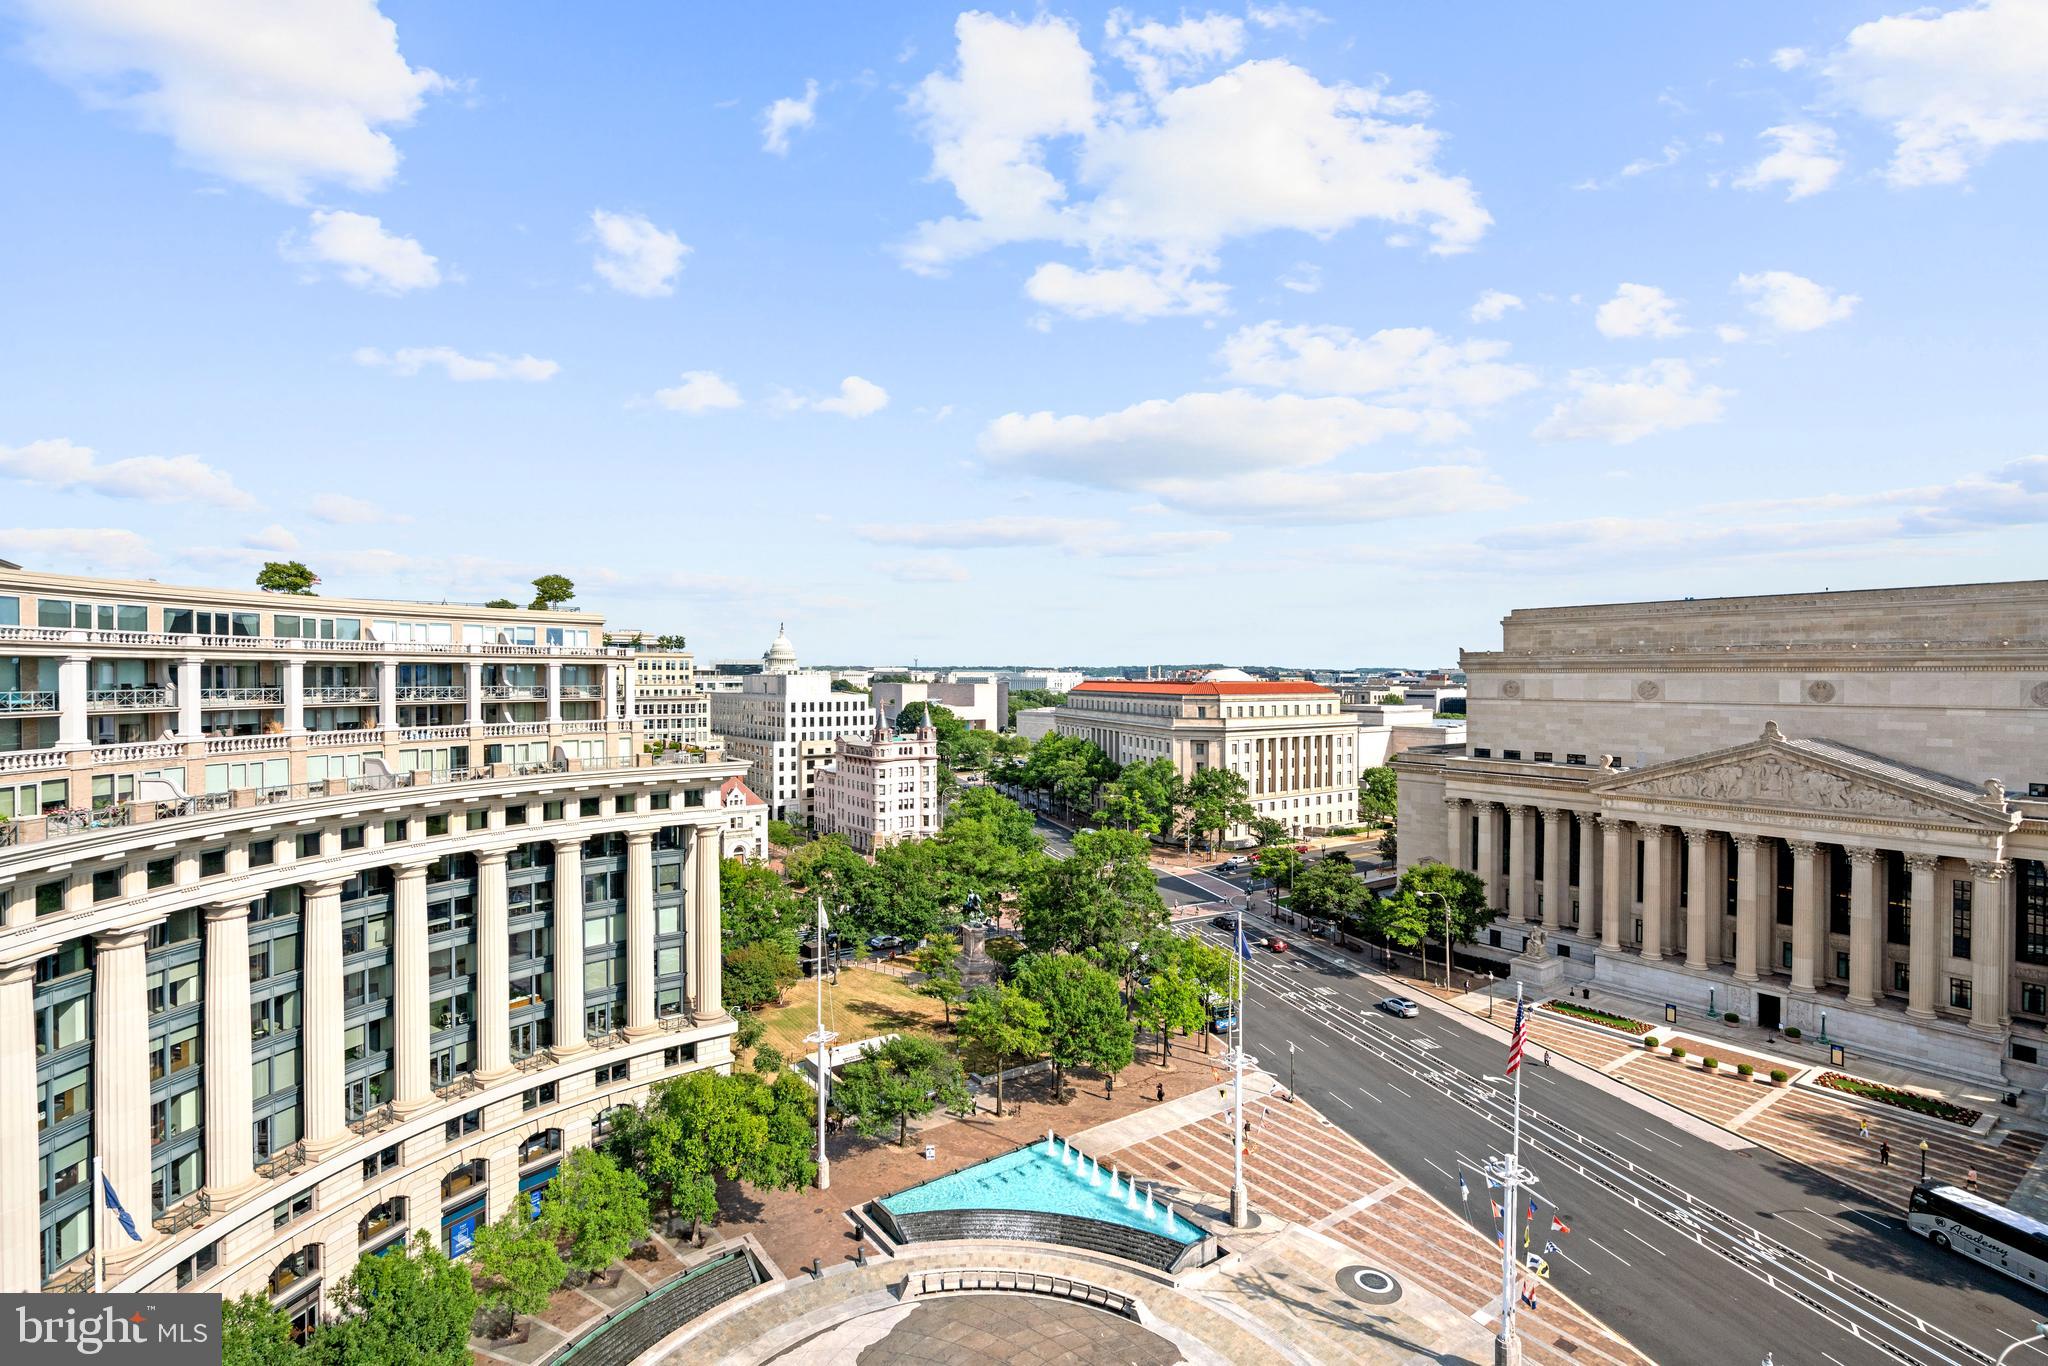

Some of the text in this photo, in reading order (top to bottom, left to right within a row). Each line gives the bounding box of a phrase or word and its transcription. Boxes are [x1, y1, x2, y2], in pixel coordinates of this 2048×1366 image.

[1663, 806, 1709, 816] ARCHIVES
[1727, 811, 1745, 819] THE
[1748, 814, 1785, 824] UNITED
[1789, 818, 1825, 828] STATES
[1846, 824, 1901, 835] AMERICA
[1950, 1224, 2008, 1258] Academy
